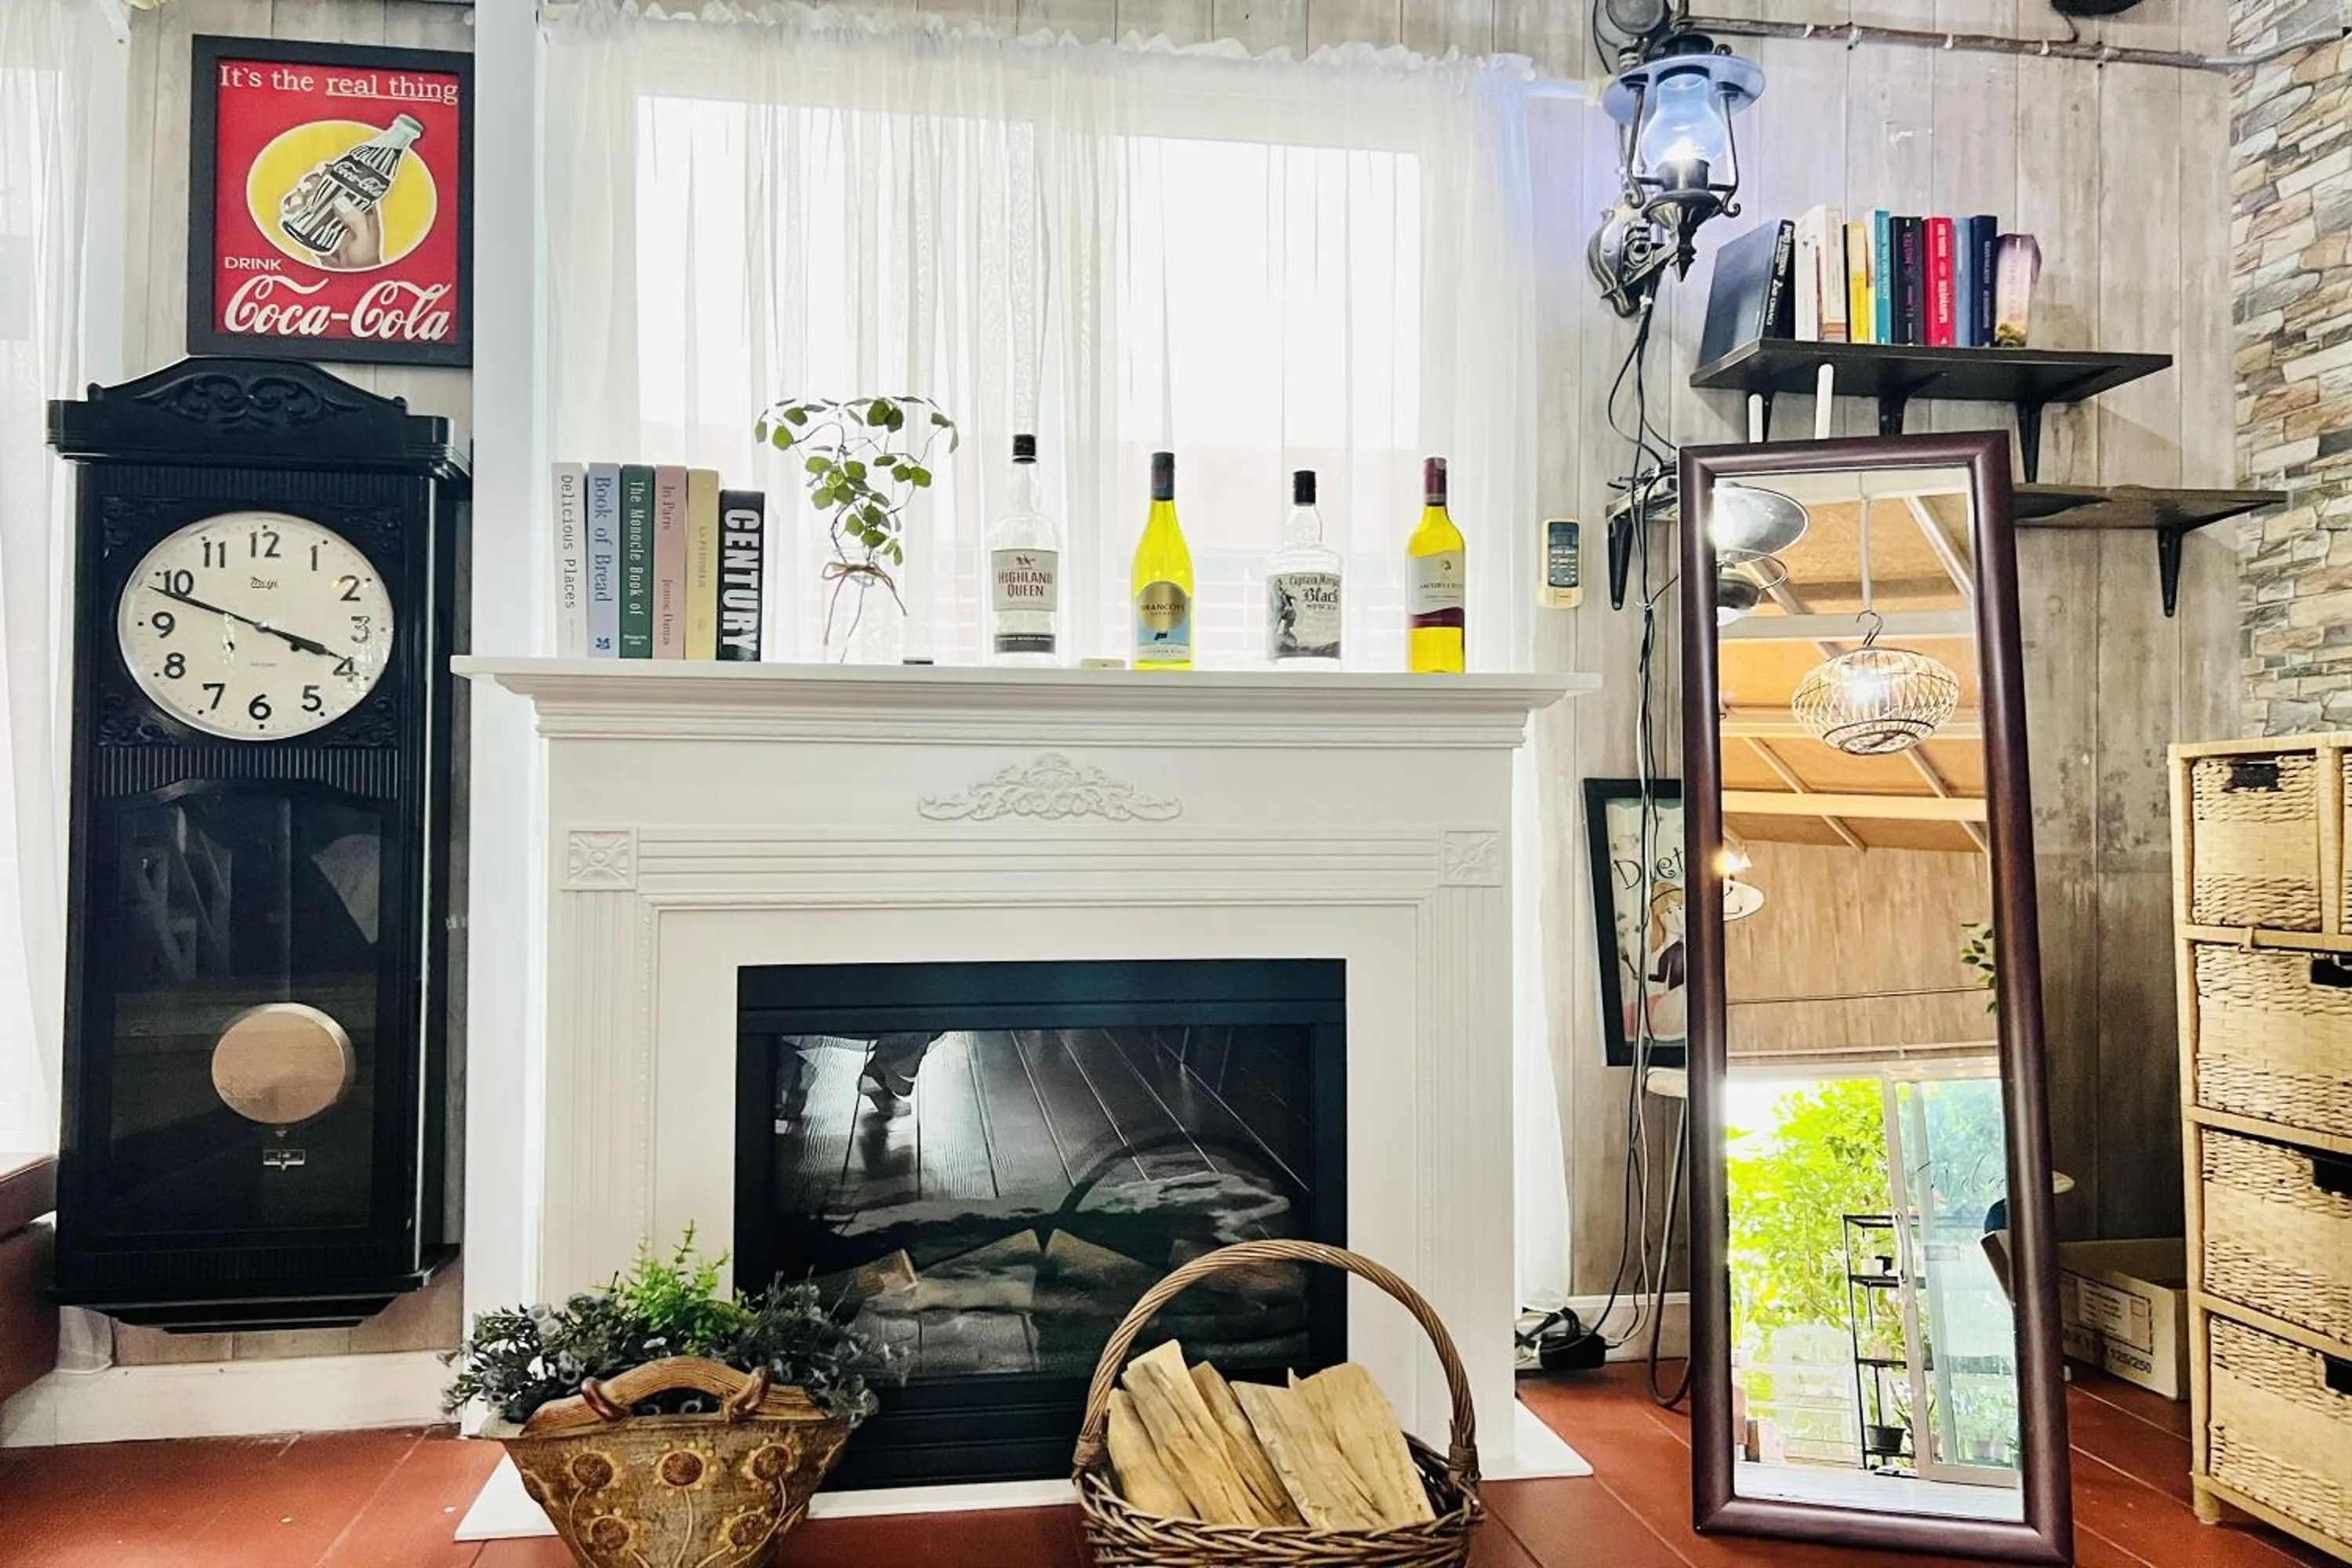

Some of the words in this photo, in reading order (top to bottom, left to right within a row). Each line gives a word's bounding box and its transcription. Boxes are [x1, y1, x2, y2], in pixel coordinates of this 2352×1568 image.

[220, 65, 263, 88] It's
[271, 70, 314, 91] the
[326, 75, 377, 96] real
[390, 77, 459, 104] thing
[333, 161, 388, 198] Coca-Cola
[224, 256, 282, 270] DRINK
[224, 275, 452, 341] Coca-Cola
[593, 477, 612, 519] Book
[630, 481, 645, 503] The
[663, 485, 675, 499] In
[561, 475, 575, 550] Delicious
[663, 502, 675, 531] Paris
[250, 531, 281, 558] 12
[595, 528, 612, 546] of
[629, 509, 645, 561] Monocle
[203, 540, 226, 568] 11
[310, 545, 318, 572] 1
[163, 569, 194, 596] 10
[339, 575, 361, 602] 2
[564, 558, 578, 609] Places
[594, 554, 612, 602] Bread
[630, 566, 644, 597] Book
[722, 509, 760, 652] CENTURY
[998, 572, 1053, 584] HIGHLAND
[1007, 584, 1044, 597] QUEEN
[1302, 587, 1338, 603] Black
[630, 603, 643, 615] of
[151, 612, 176, 638] 9
[350, 615, 371, 643] 3
[164, 652, 186, 679] 8
[332, 656, 359, 682] 4
[202, 683, 226, 710] 7
[249, 694, 272, 720] 6
[301, 685, 322, 712] 5
[1613, 847, 1683, 890] Det
